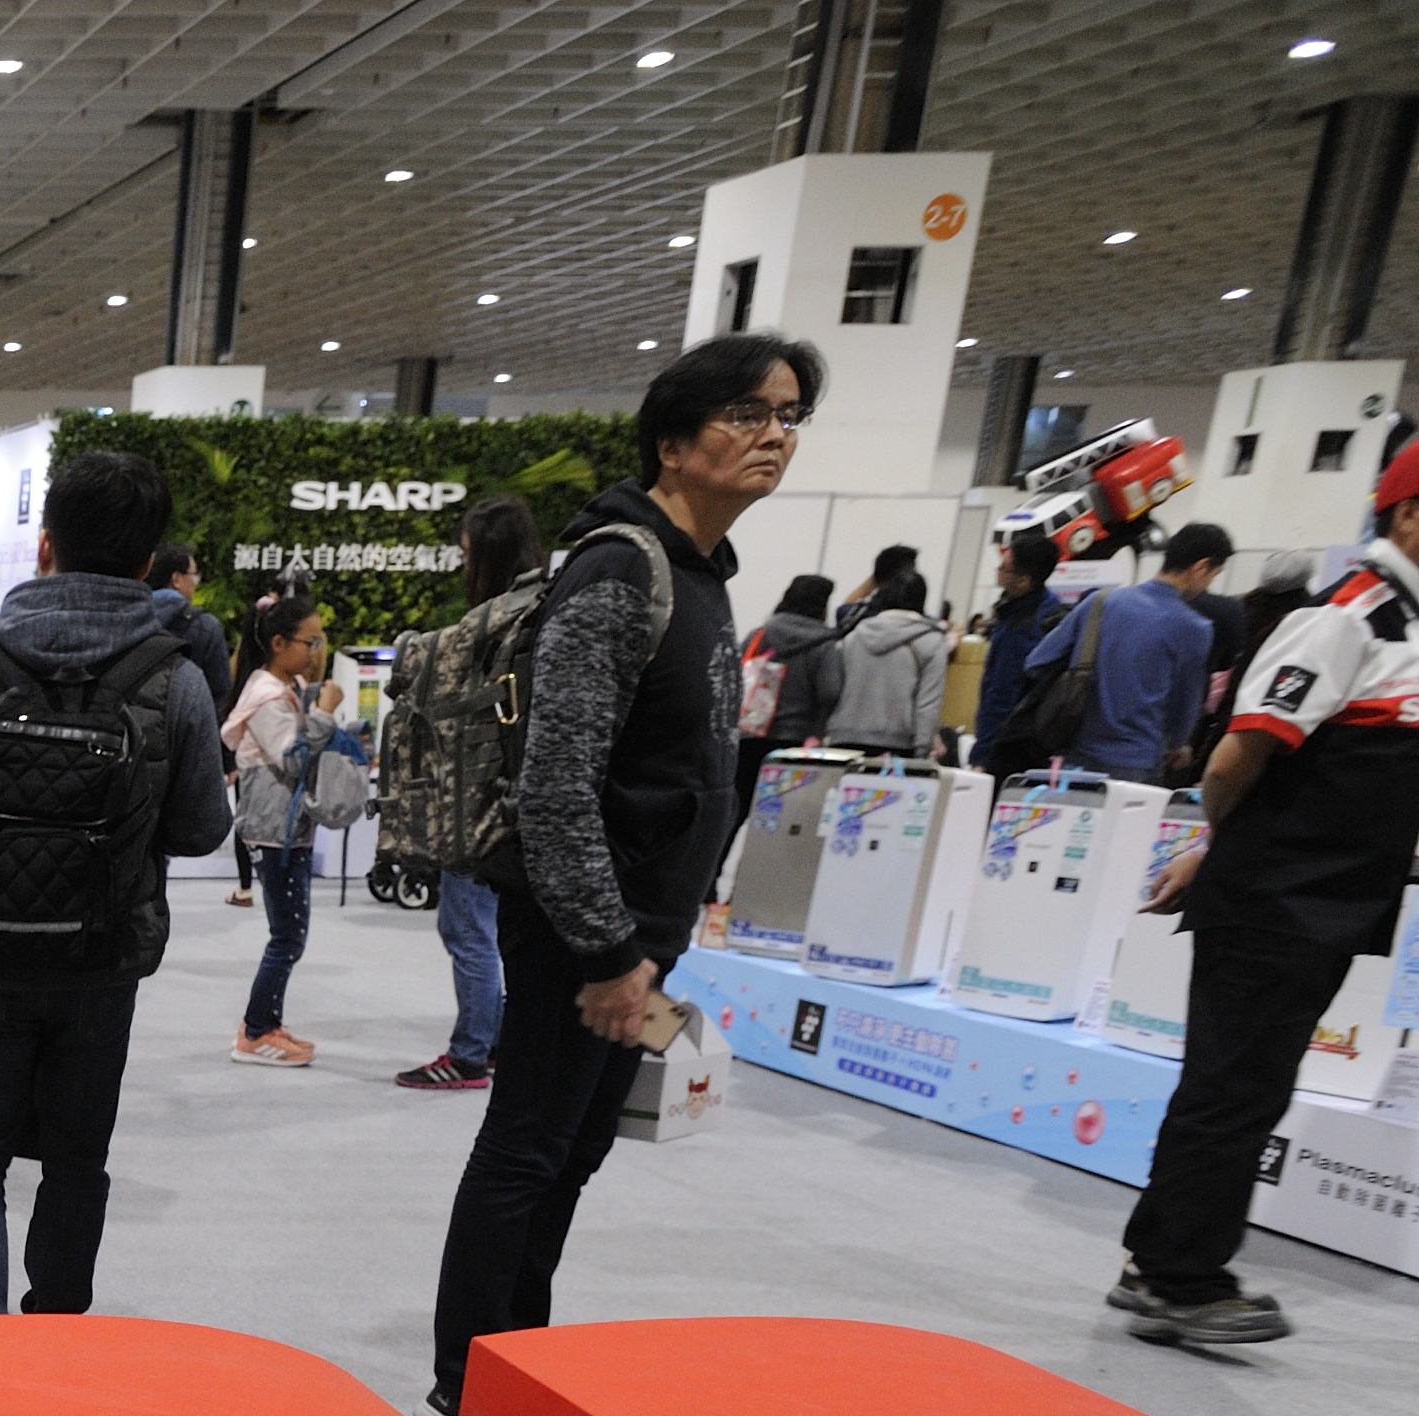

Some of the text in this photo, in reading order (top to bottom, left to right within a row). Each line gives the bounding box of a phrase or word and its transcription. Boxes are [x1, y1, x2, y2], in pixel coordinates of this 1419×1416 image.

[925, 204, 966, 229] 2-7
[290, 480, 467, 511] SHARP
[1297, 1149, 1419, 1197] Plasmaclu
